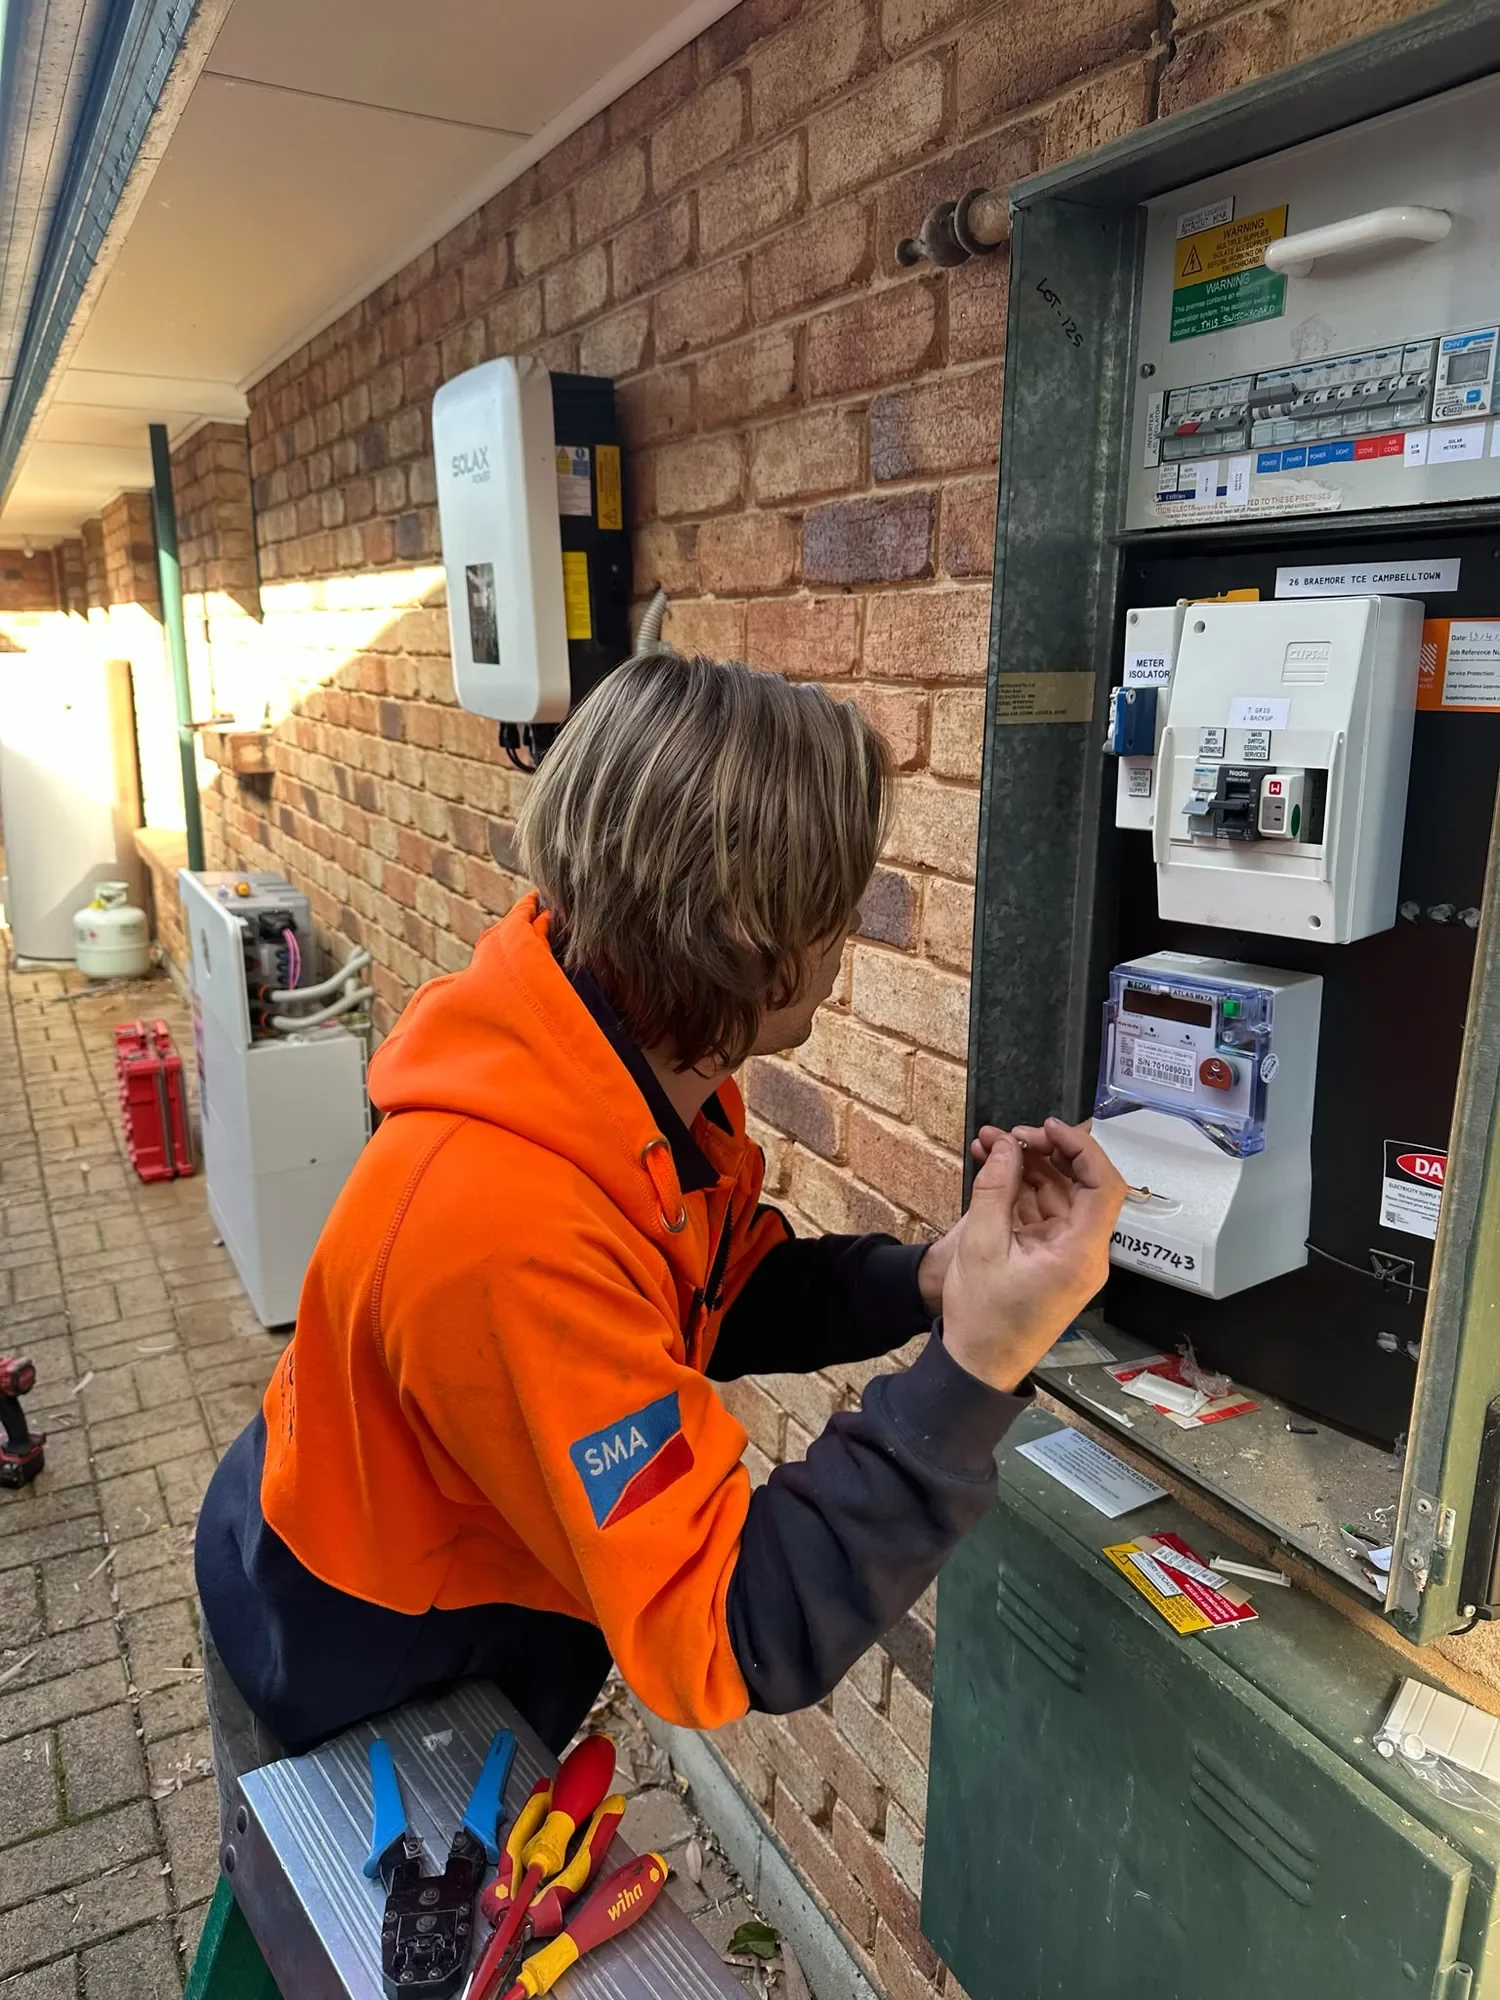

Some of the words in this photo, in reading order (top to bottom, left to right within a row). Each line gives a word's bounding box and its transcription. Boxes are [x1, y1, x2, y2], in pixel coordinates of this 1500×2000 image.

[1223, 218, 1264, 240] WARNING
[1212, 248, 1234, 260] ISOLATE
[1236, 245, 1246, 255] ALL
[1246, 236, 1272, 250] SUPPLIES
[1216, 236, 1242, 251] MULTIPLE
[1244, 228, 1269, 243] SUPPLIES
[1207, 258, 1228, 270] BEFORE
[1229, 251, 1254, 265] WORKING
[1222, 256, 1260, 272] SWITCHBOARD
[1206, 272, 1250, 295] WARNING
[1174, 305, 1185, 314] This
[1201, 319, 1218, 330] THIS
[1310, 452, 1326, 460] POWER
[1336, 448, 1350, 456] LIGHT
[452, 446, 490, 477] SOLAX
[1271, 494, 1294, 504] THESE
[1295, 492, 1332, 502] PREMISES
[1289, 578, 1300, 586] 26
[1304, 576, 1346, 586] BRAEMORE
[1351, 576, 1367, 584] TCE
[1372, 572, 1441, 582] CAMPBELLTOWN
[1452, 634, 1467, 642] Date:
[1289, 647, 1329, 660] CLIPSAL
[1462, 648, 1491, 656] Reference
[1136, 659, 1164, 668] METER
[1129, 670, 1170, 679] ISOLATOR
[1174, 990, 1194, 1000] ATLAS
[1389, 1182, 1418, 1194] ELECTRICITY
[1419, 1190, 1437, 1199] SUPPLY
[1110, 1230, 1195, 1270] 017357743
[584, 1426, 648, 1476] SMA
[1071, 1431, 1112, 1460] SHUTDOWN
[1111, 1458, 1160, 1492] PROCEDURE
[1137, 1552, 1158, 1573] BATTERY
[1156, 1568, 1180, 1594] LOCATED
[1184, 1583, 1203, 1600] SYSTEM
[1200, 1600, 1221, 1620] BATTERY
[607, 1882, 644, 1922] wiha
